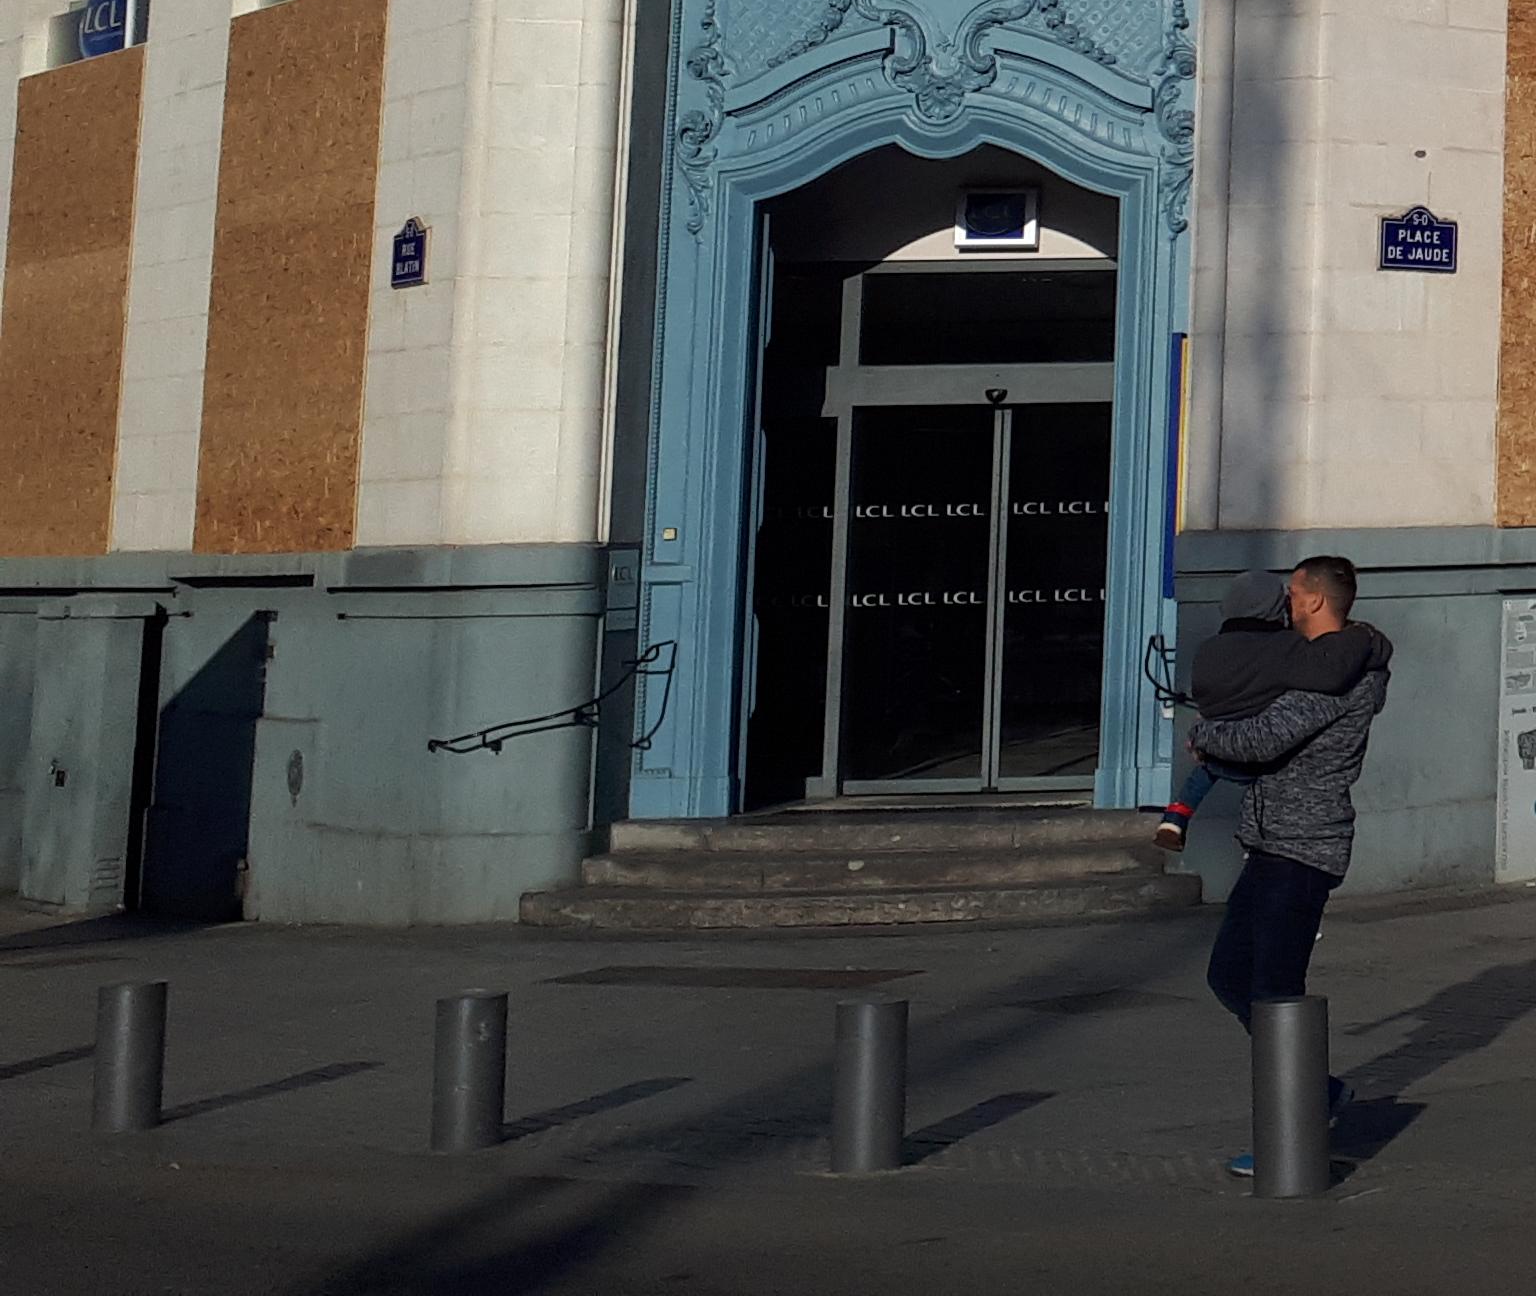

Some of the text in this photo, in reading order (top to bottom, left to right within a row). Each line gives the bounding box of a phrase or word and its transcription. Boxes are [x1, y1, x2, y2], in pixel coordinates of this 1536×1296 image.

[83, 0, 122, 34] LCL
[1398, 229, 1441, 244] PLACE
[401, 242, 416, 257] RUE
[1387, 246, 1450, 262] DE JAUDE
[855, 504, 895, 518] LCL
[901, 503, 940, 518] LCL
[946, 503, 984, 517] LCL
[1013, 501, 1052, 516] LCL
[1058, 500, 1097, 515] LCL
[851, 593, 892, 608] LCL
[898, 591, 937, 606] LCL
[943, 591, 984, 605] LCL
[1008, 589, 1048, 604] LCL
[1053, 588, 1094, 603] LCL
